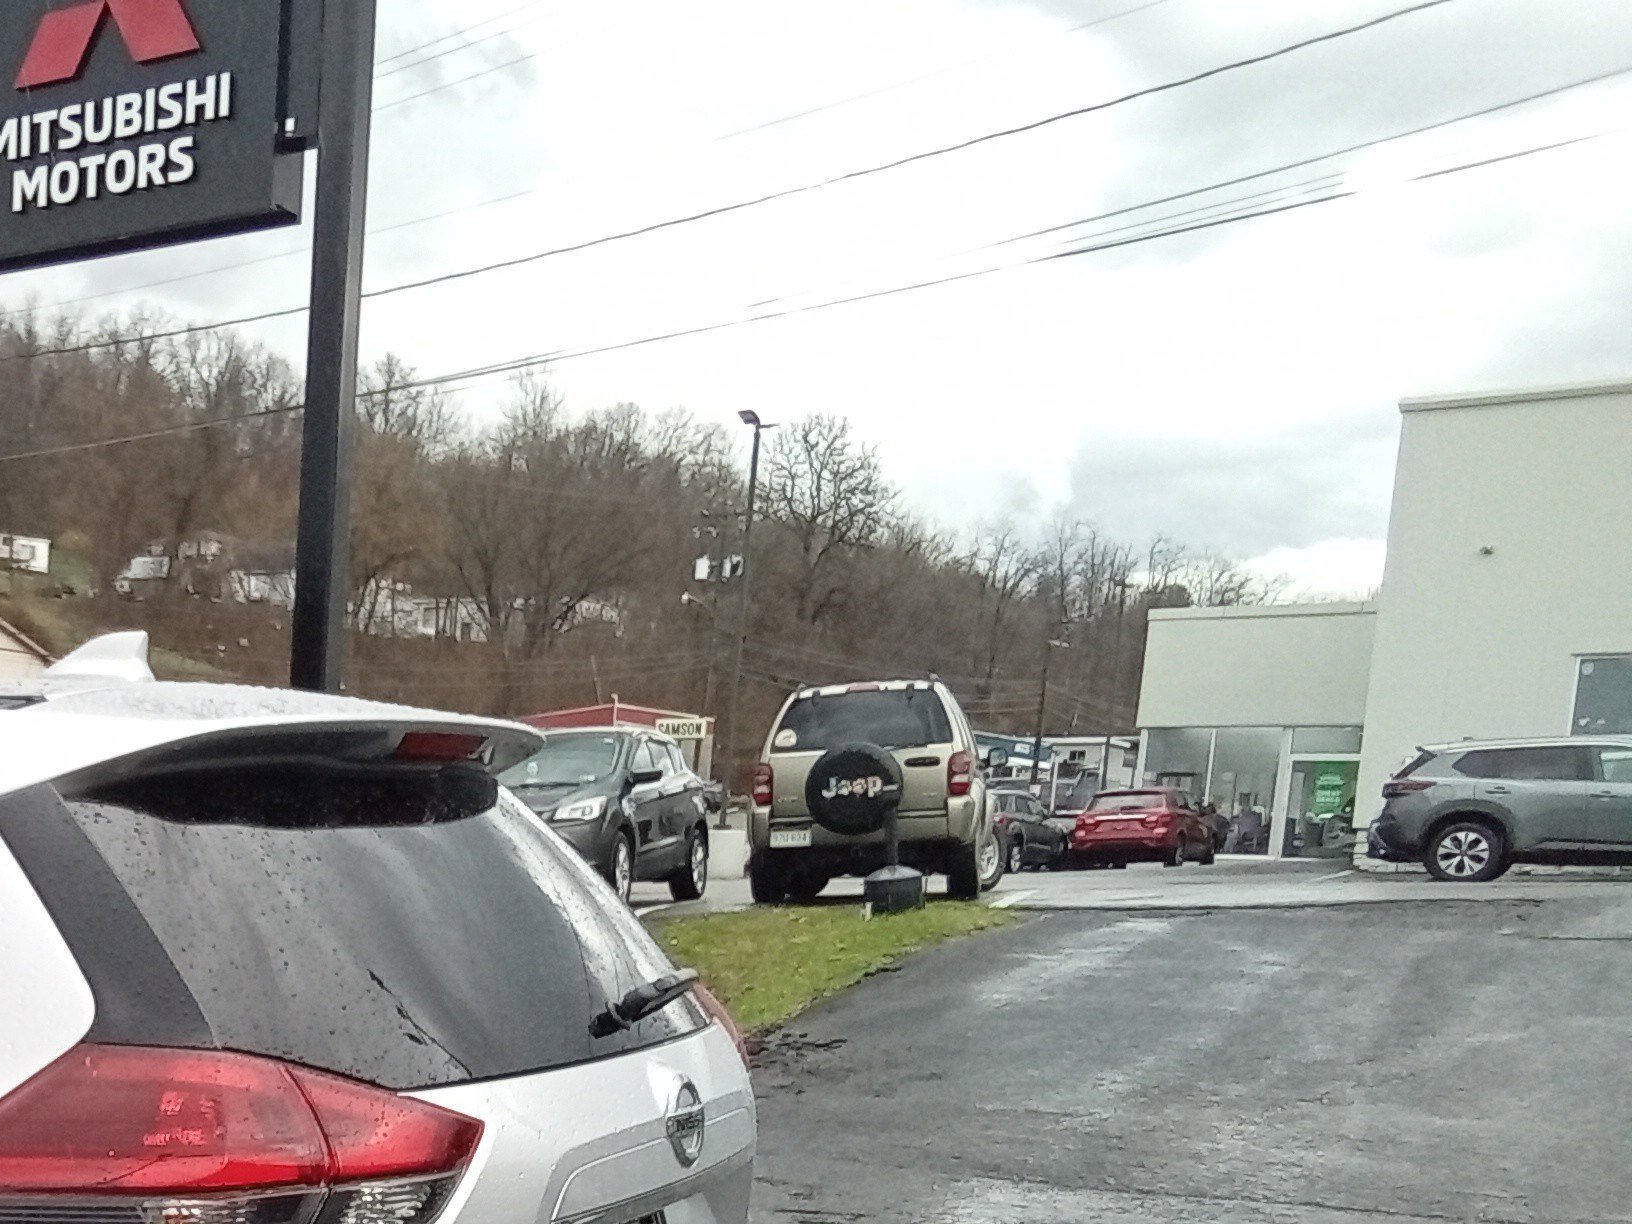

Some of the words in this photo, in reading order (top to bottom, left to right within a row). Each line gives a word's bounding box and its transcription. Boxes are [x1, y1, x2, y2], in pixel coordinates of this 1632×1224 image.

[11, 135, 197, 214] MOTORS
[658, 722, 703, 736] SAMSON
[821, 775, 883, 799] Jeep
